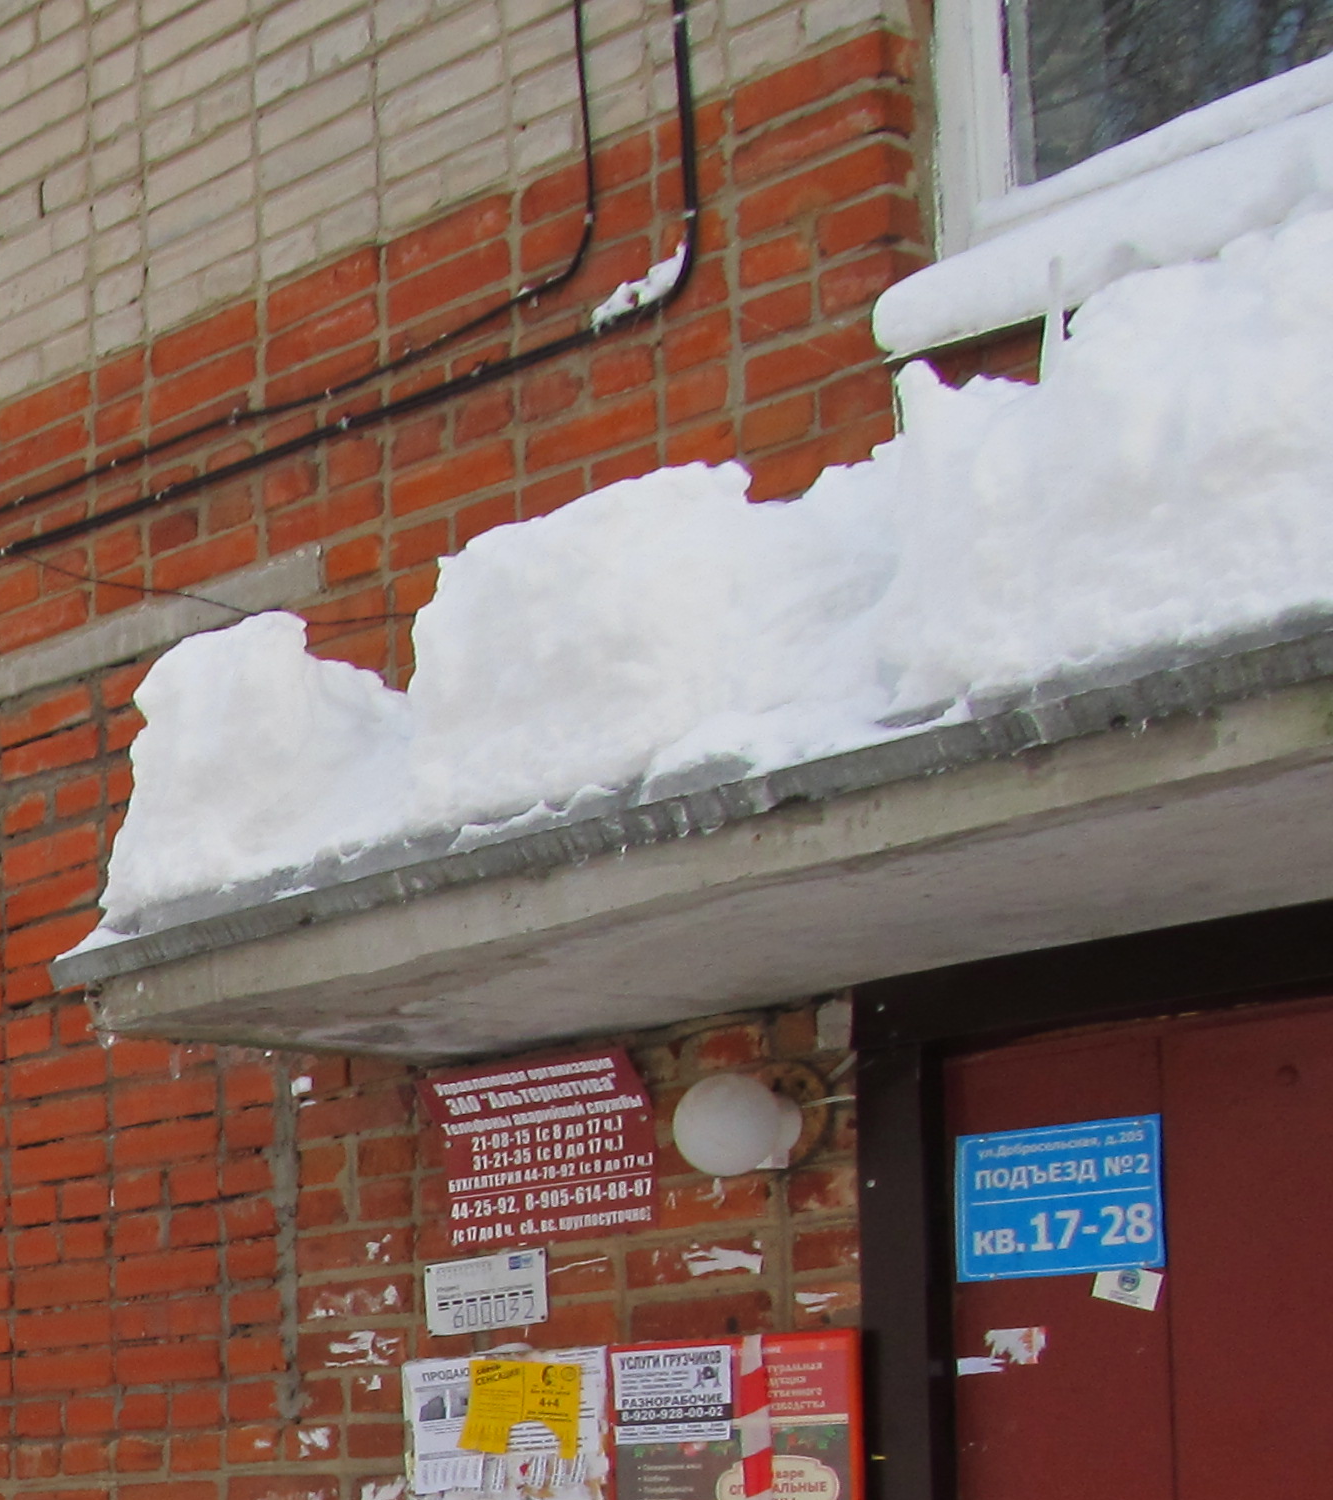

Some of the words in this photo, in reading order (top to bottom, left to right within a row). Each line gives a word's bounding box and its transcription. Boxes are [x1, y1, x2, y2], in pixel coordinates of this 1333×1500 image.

[433, 1071, 527, 1097] Управляющая
[528, 1057, 615, 1080] организация
[441, 1115, 512, 1136] Телефоны
[512, 1102, 584, 1126] аварийной
[585, 1095, 643, 1115] службы
[445, 1095, 481, 1116] ЗАО
[471, 1129, 531, 1152] 21-08-15
[552, 1124, 562, 1141] 8
[565, 1122, 584, 1139] до
[586, 1119, 601, 1135] 17
[603, 1115, 623, 1132] ч.)
[472, 1148, 532, 1171] 31-21-35
[553, 1145, 563, 1160] 8
[565, 1141, 584, 1159] до
[587, 1138, 602, 1154] 17
[604, 1135, 624, 1151] ч.)
[448, 1171, 522, 1193] БУХГАЛТЕРИЯ
[523, 1163, 576, 1182] 44-70-92
[593, 1159, 602, 1174] 8
[603, 1157, 621, 1172] до
[623, 1154, 635, 1169] 17
[636, 1152, 653, 1167] ч.)
[974, 1158, 1098, 1191] ПОДЪЕЗД
[1104, 1153, 1150, 1177] №2
[450, 1196, 521, 1220] 44-25-92,
[524, 1178, 652, 1212] 8-905-614-88-87
[466, 1227, 477, 1242] 17
[478, 1227, 494, 1242] до
[494, 1223, 502, 1239] 8
[503, 1225, 515, 1237] ч.
[541, 1218, 558, 1232] вс.
[453, 1296, 534, 1328] 600032
[619, 1355, 661, 1370] УСЛУГИ
[663, 1350, 721, 1368] ГРУЗЧИКОВ
[621, 1393, 723, 1408] РАЗНОРАБОЧИЕ
[621, 1406, 724, 1422] 8-920-928-00-02
[729, 1481, 828, 1496] СПАЛЬНЫЕ
